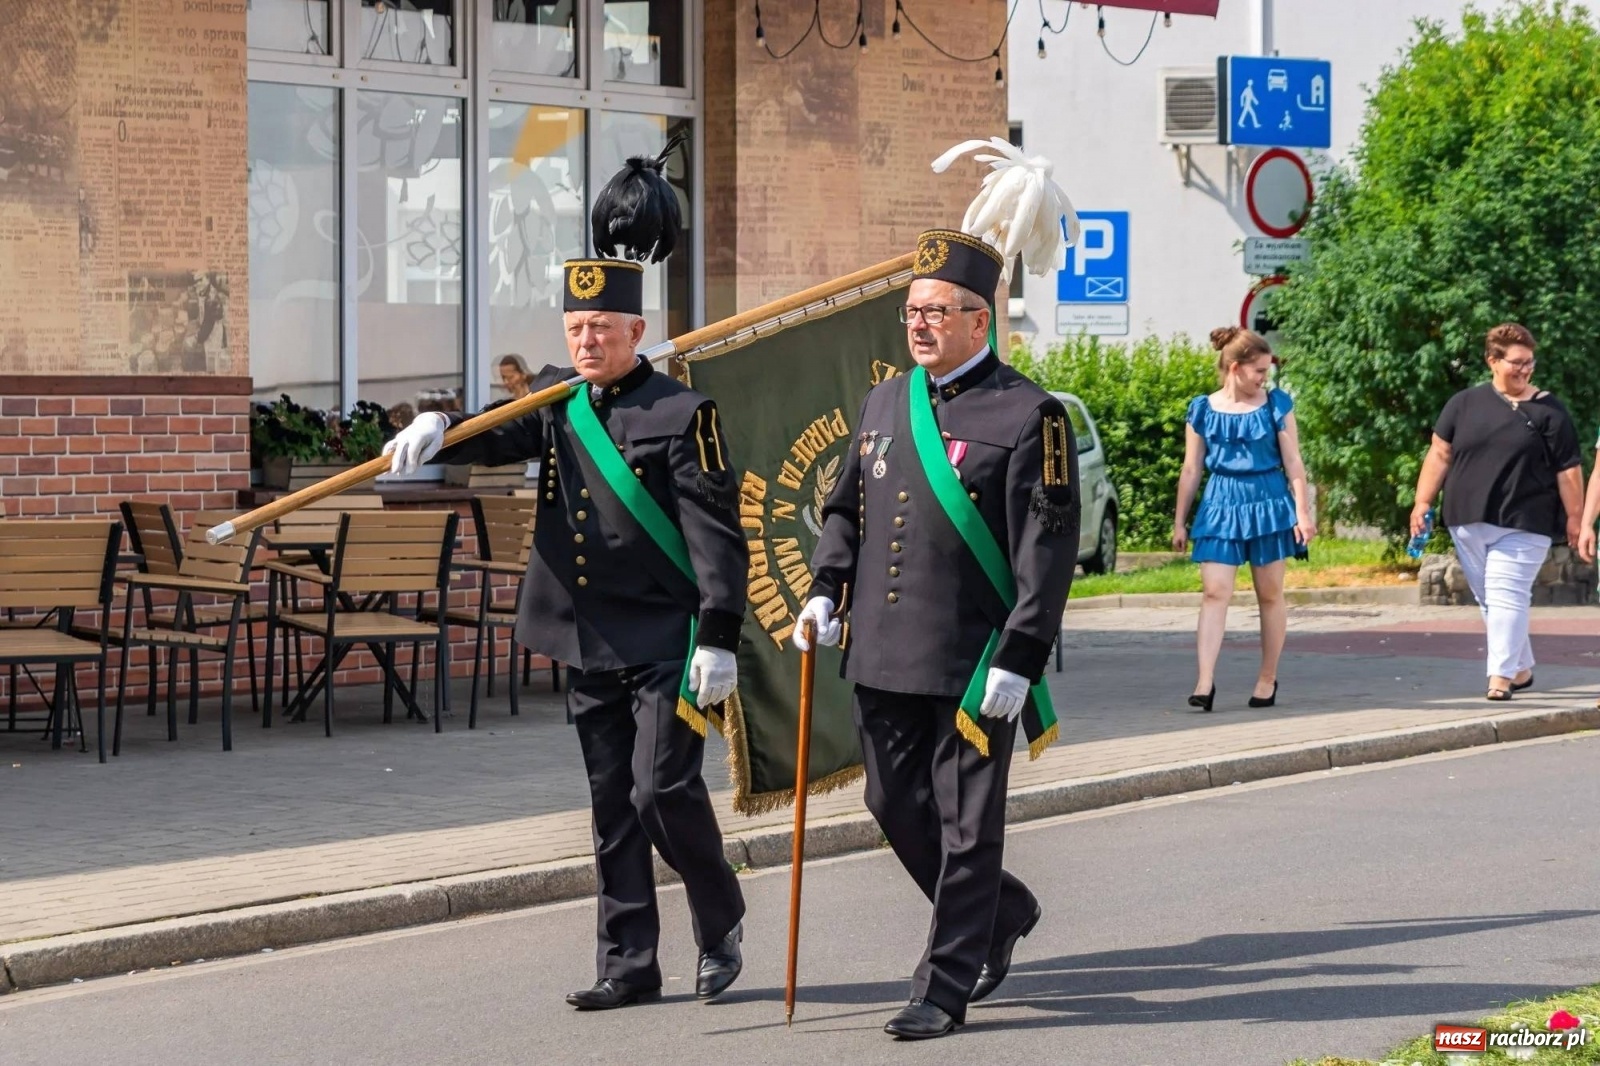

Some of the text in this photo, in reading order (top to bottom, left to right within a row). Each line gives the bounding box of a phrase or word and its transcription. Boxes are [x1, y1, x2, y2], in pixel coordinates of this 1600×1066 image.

[1074, 219, 1115, 276] P
[777, 407, 850, 491] PARAFIA
[772, 498, 796, 524] N.
[739, 470, 798, 651] RACIBÓRZ
